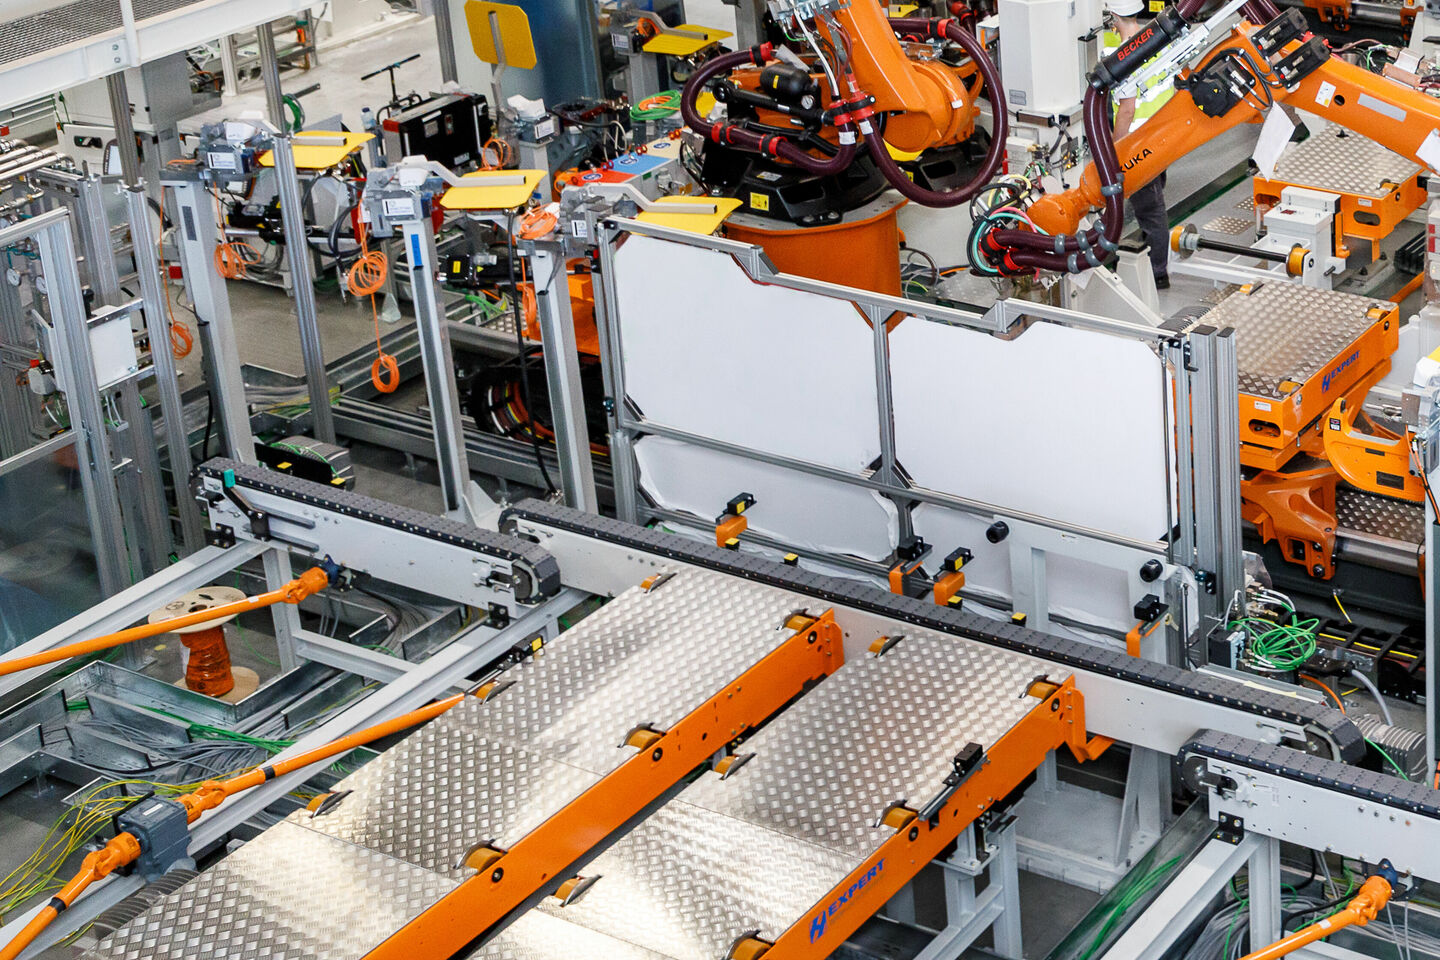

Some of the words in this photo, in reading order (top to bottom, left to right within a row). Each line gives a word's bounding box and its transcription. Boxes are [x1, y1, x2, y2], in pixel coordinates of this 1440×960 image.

[1117, 28, 1155, 62] BECKER
[1331, 350, 1360, 379] EXPERT
[828, 857, 886, 917] EXPERT
